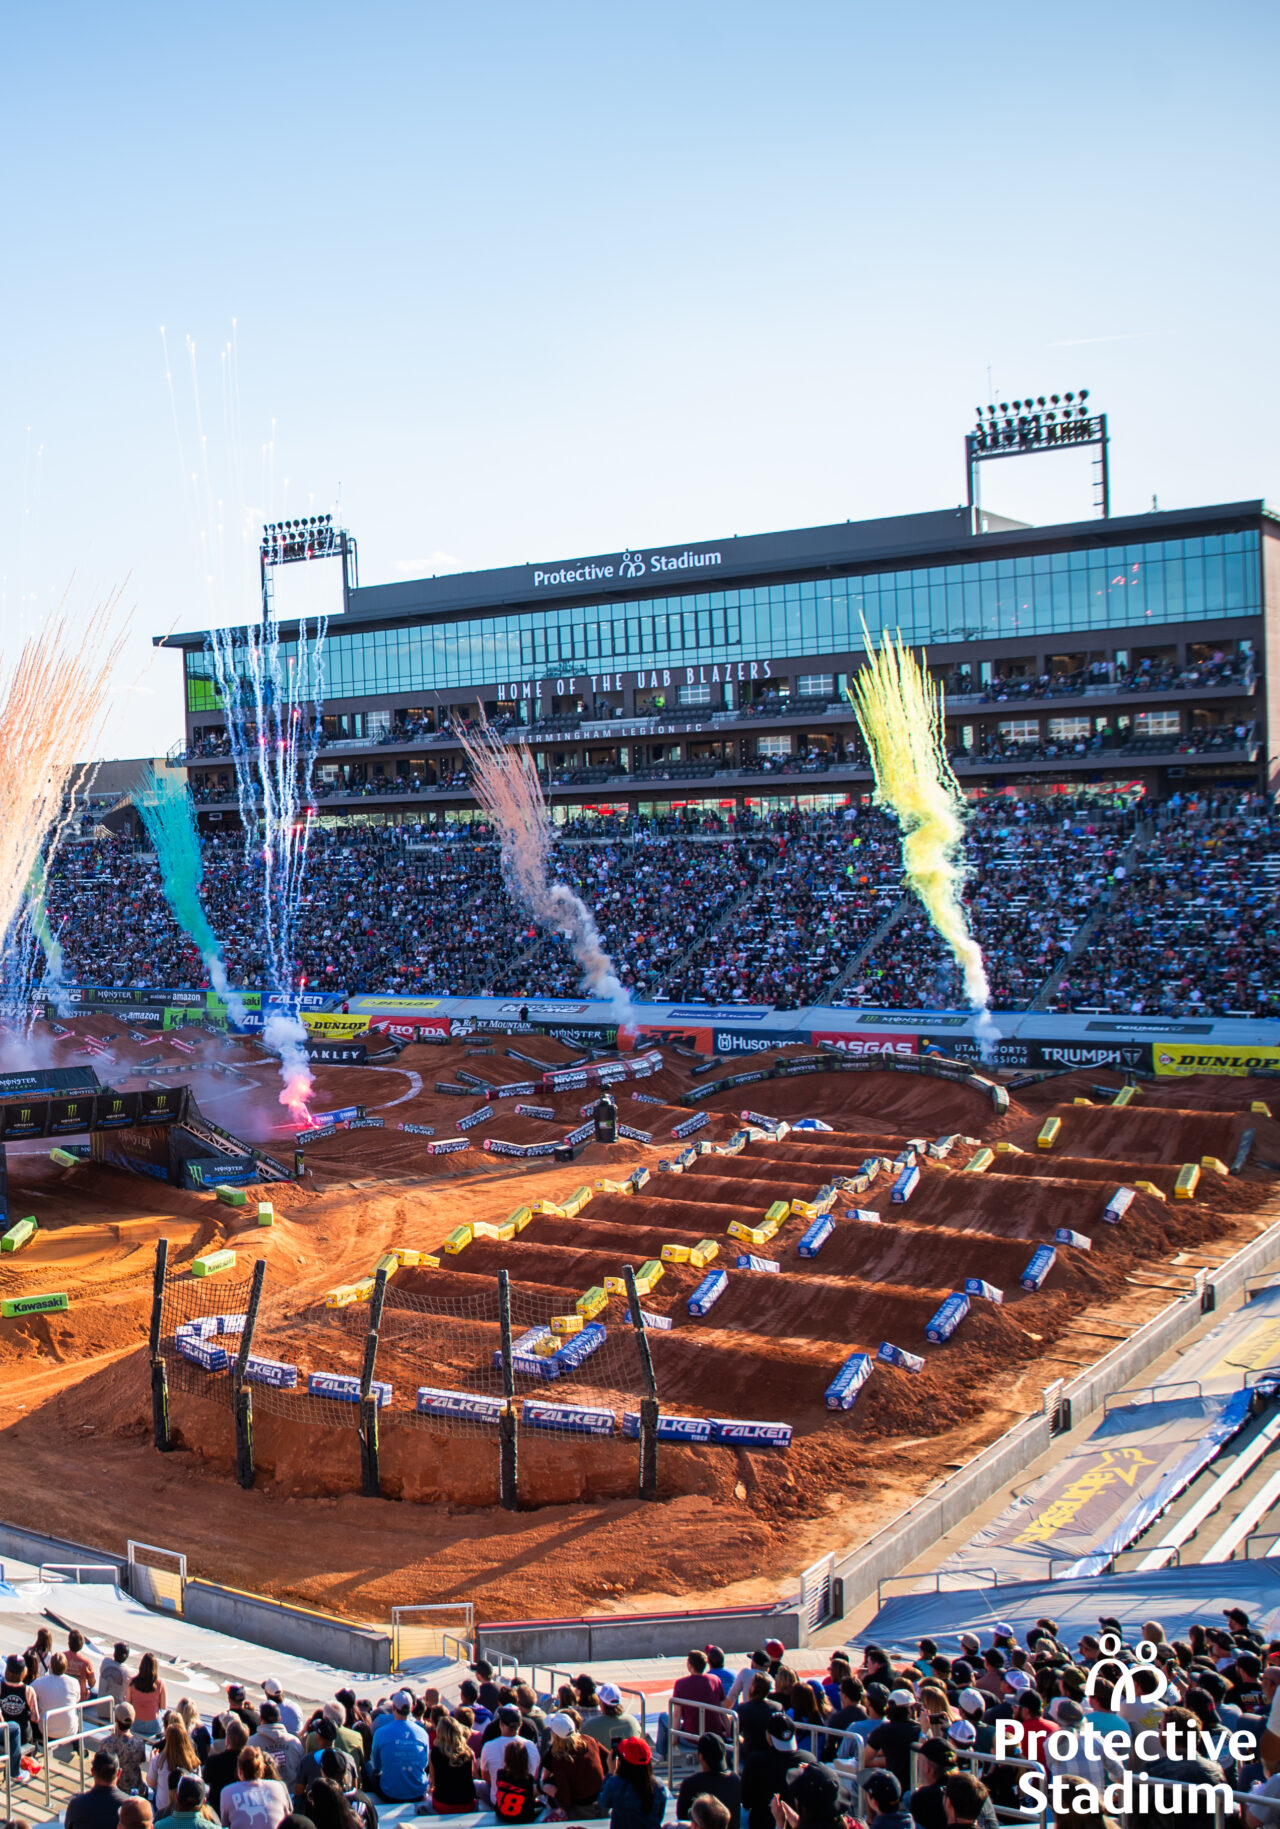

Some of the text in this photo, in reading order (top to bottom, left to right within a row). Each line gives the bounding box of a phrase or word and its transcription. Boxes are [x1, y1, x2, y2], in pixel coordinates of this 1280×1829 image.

[533, 551, 722, 586] Protective Stadium
[497, 660, 772, 701] HOME OF THE UAB BLAZERS
[519, 722, 703, 744] BIRMINGHAM LEGION FC
[97, 990, 132, 1000] MONSTER
[172, 993, 201, 1002] amazon
[268, 994, 323, 1005] FALKEN
[374, 999, 435, 1008] DUNLOP
[128, 1011, 160, 1021] amazon
[881, 1015, 943, 1024] MONSTER
[313, 1021, 366, 1031] DUNLOP
[489, 1020, 532, 1029] MOUNTAIN
[1114, 1024, 1170, 1032] TRIUMPH
[549, 1029, 602, 1040] MONSTER
[1041, 1047, 1122, 1069] TRIUMPH
[1178, 1055, 1280, 1070] DUNLOP
[0, 1077, 37, 1087] MONSTER
[13, 1296, 63, 1314] Kawasaki
[180, 1341, 211, 1365] FALKEN
[513, 1359, 541, 1375] AMAHA
[420, 1395, 505, 1417] FALKEN
[481, 1414, 501, 1423] TIRES
[528, 1407, 613, 1428] FALKEN
[590, 1426, 610, 1434] TIRES
[721, 1425, 792, 1439] FALKEN
[690, 1433, 708, 1442] TIRES
[231, 1789, 274, 1807] PINK
[496, 1790, 526, 1817] 18
